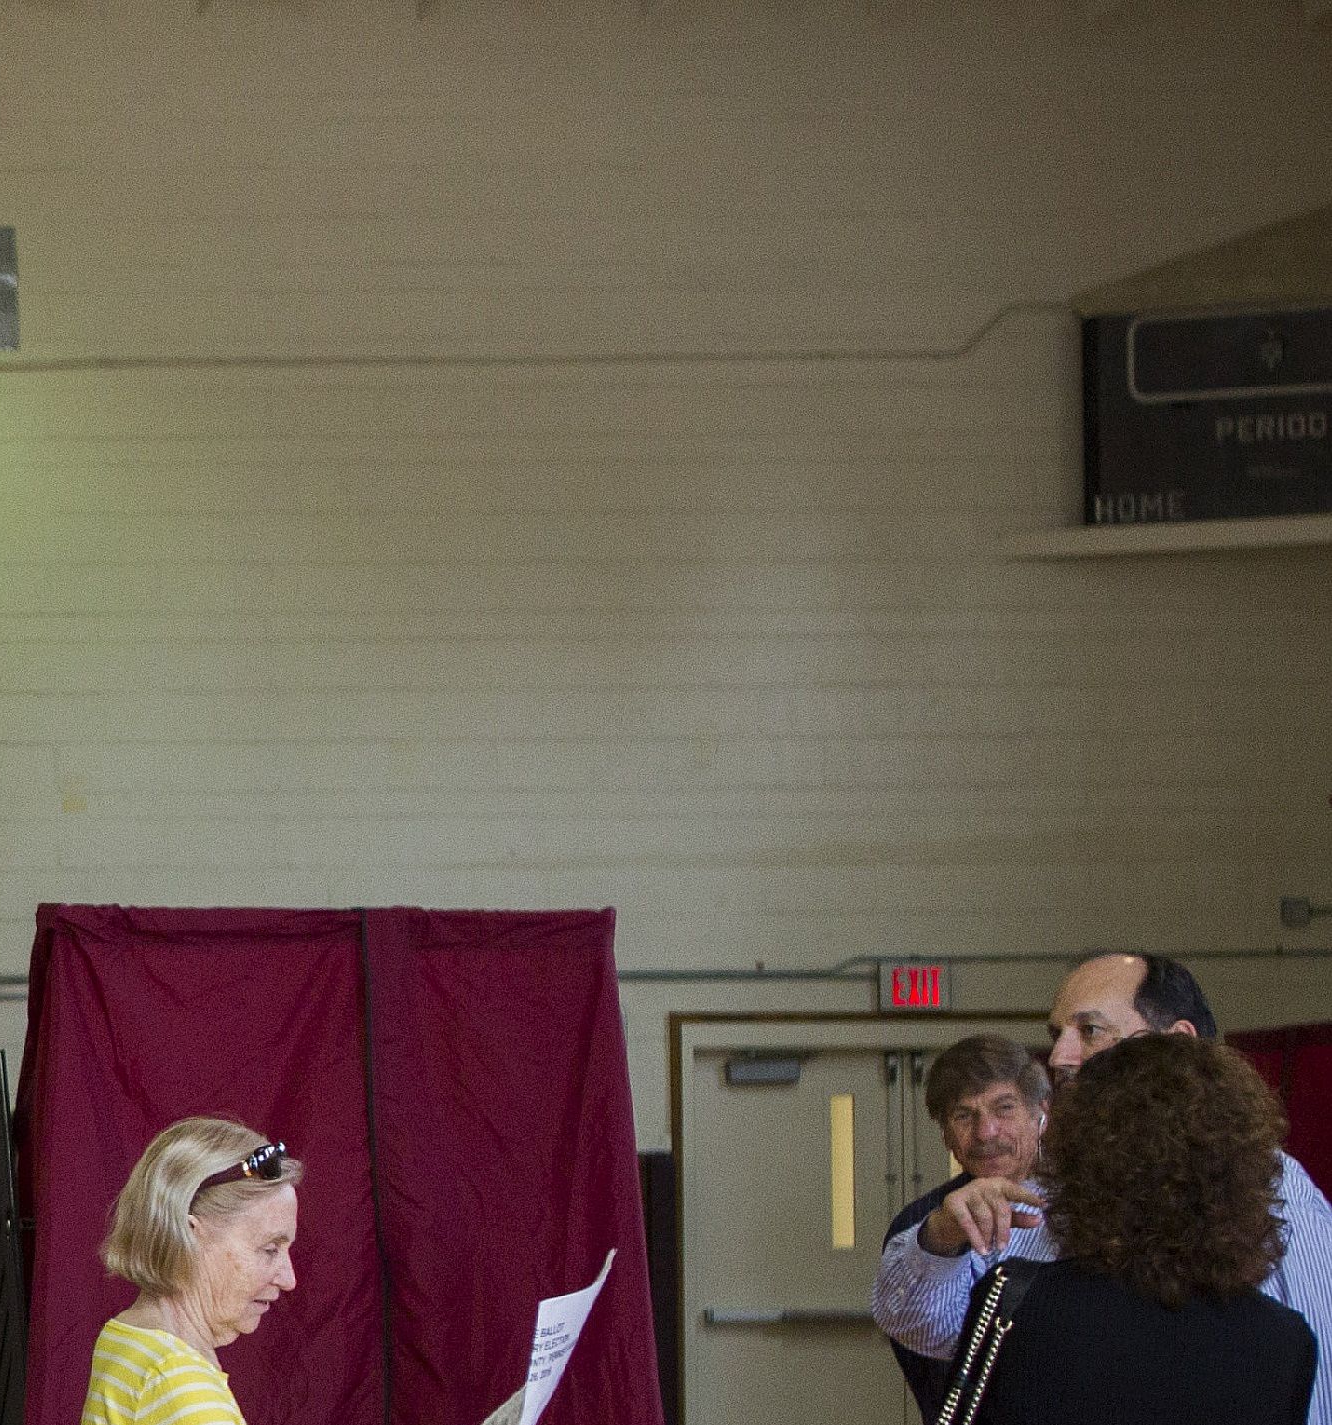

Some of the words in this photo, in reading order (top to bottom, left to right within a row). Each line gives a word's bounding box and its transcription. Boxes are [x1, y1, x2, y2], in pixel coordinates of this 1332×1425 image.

[1215, 413, 1327, 441] PERIOD
[1094, 490, 1185, 523] HOME
[891, 966, 942, 1008] EXIT
